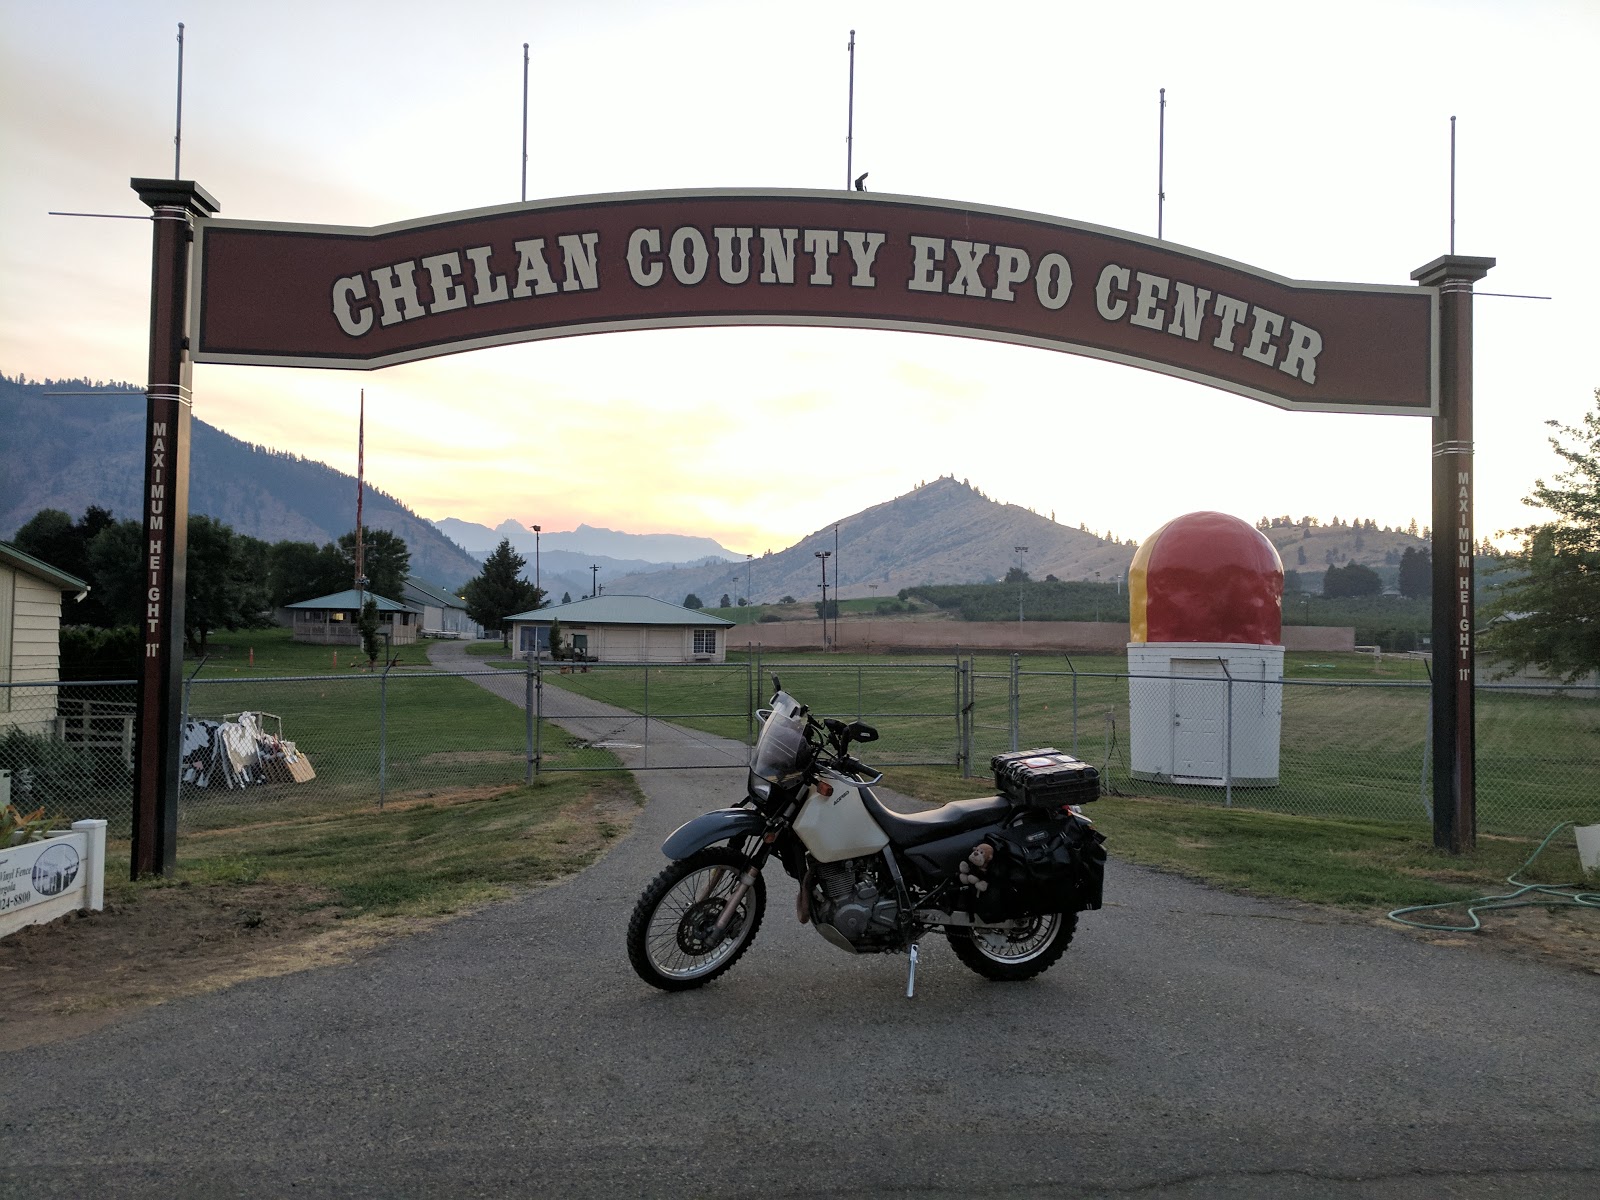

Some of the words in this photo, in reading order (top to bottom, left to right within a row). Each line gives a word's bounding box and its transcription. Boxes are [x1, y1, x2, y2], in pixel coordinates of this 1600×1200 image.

[332, 232, 599, 337] CHELAN
[626, 226, 886, 287] COUNTY
[908, 235, 1073, 310] EXPO
[1095, 264, 1323, 384] CENTER
[149, 422, 167, 530] MAXIMUM
[1458, 472, 1470, 568] MAXIMUM
[147, 540, 162, 633] HEIGHT
[1459, 576, 1470, 660] HEIGHT
[15, 867, 31, 878] Fence
